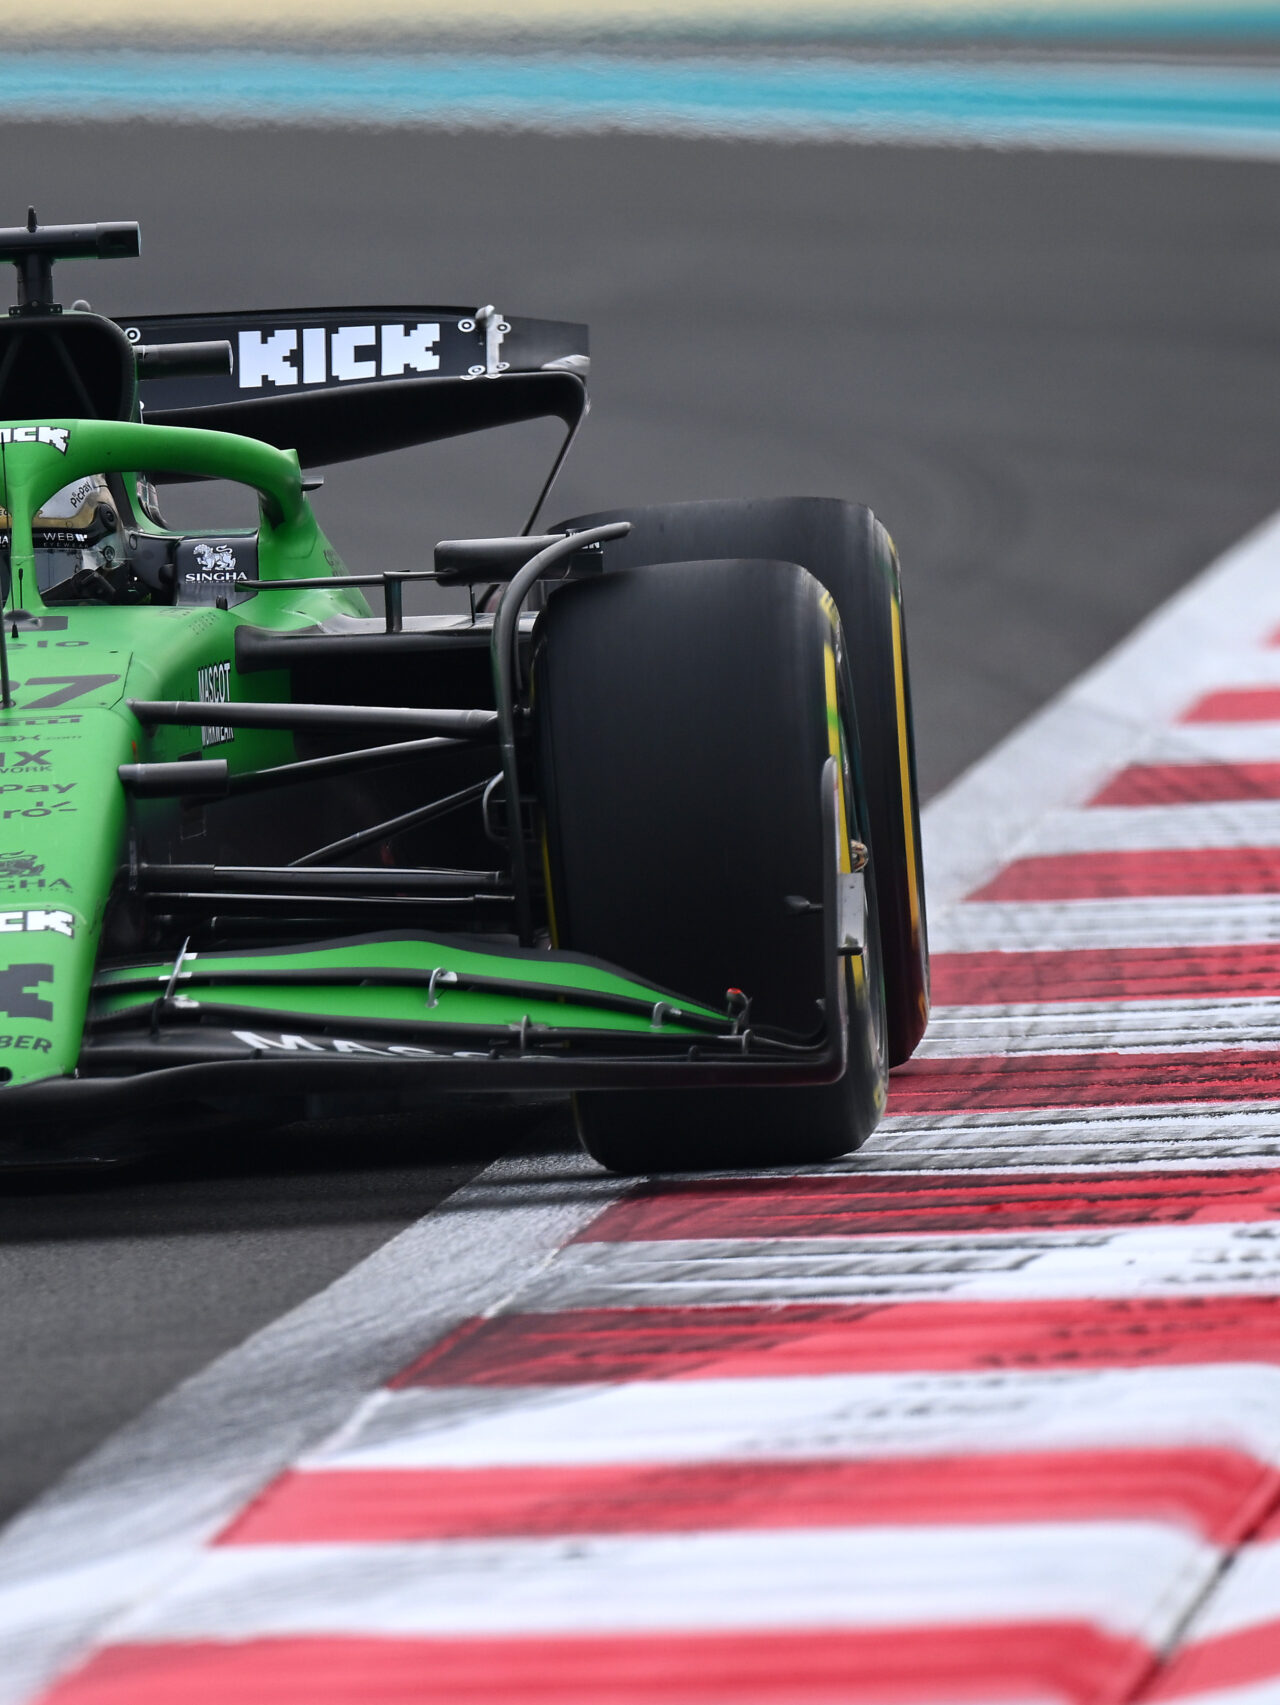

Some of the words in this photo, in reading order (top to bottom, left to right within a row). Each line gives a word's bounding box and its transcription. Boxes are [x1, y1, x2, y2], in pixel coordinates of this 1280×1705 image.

[238, 323, 441, 388] KICK
[70, 481, 93, 508] PicPay
[43, 532, 75, 541] WEB
[185, 571, 248, 582] SINGHA
[198, 662, 230, 703] MASCOT
